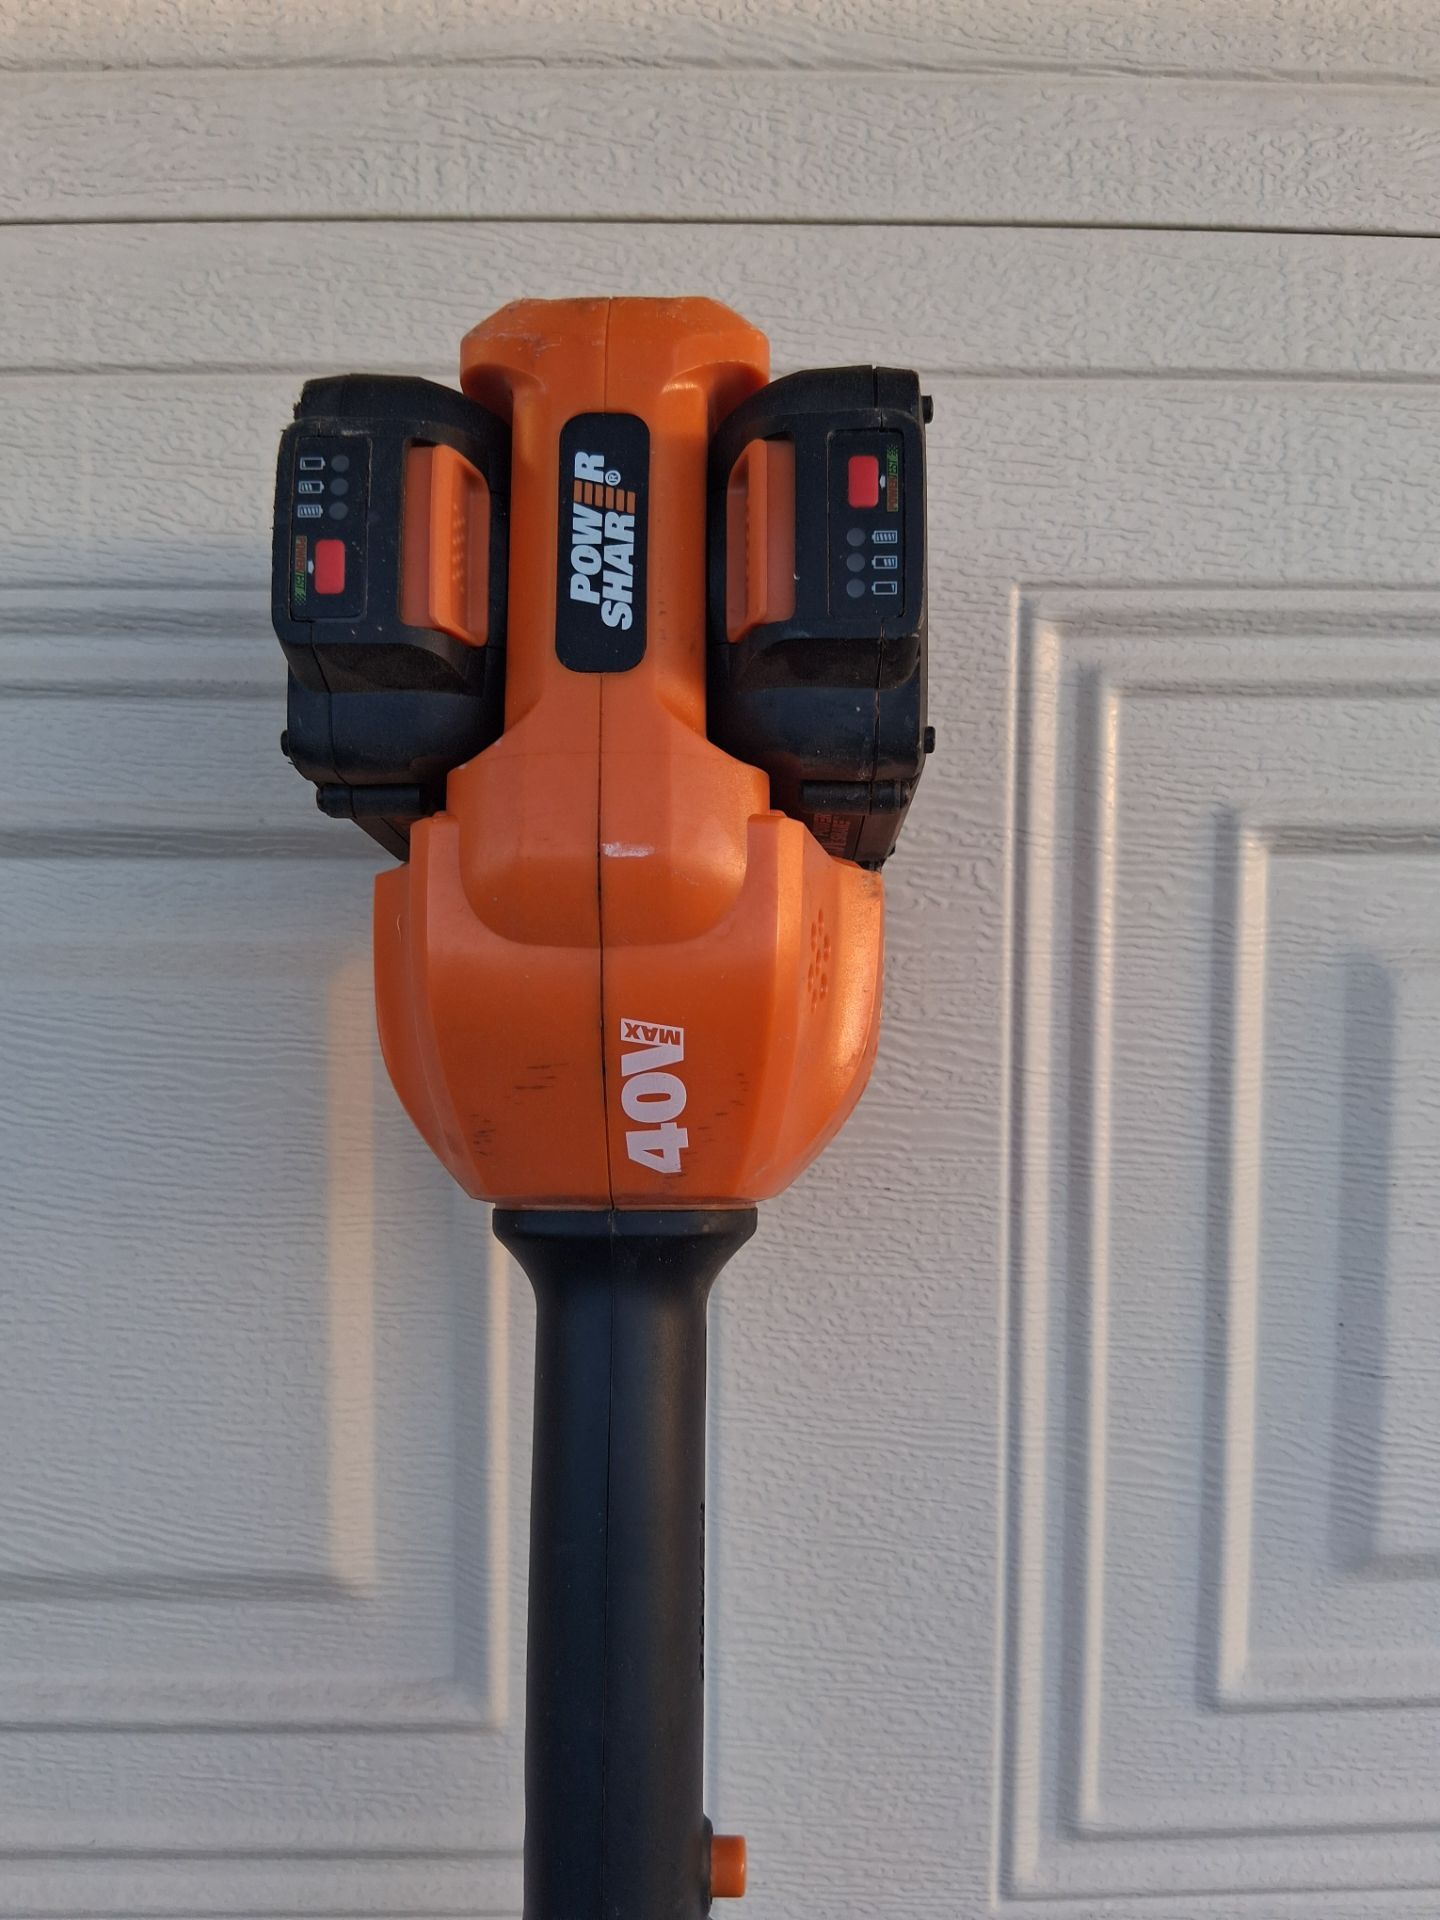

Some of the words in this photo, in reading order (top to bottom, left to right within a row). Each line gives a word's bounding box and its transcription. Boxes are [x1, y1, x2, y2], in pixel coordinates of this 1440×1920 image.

[569, 451, 605, 605] POWER
[620, 1018, 689, 1174] 40V
[623, 1021, 682, 1046] MAX
